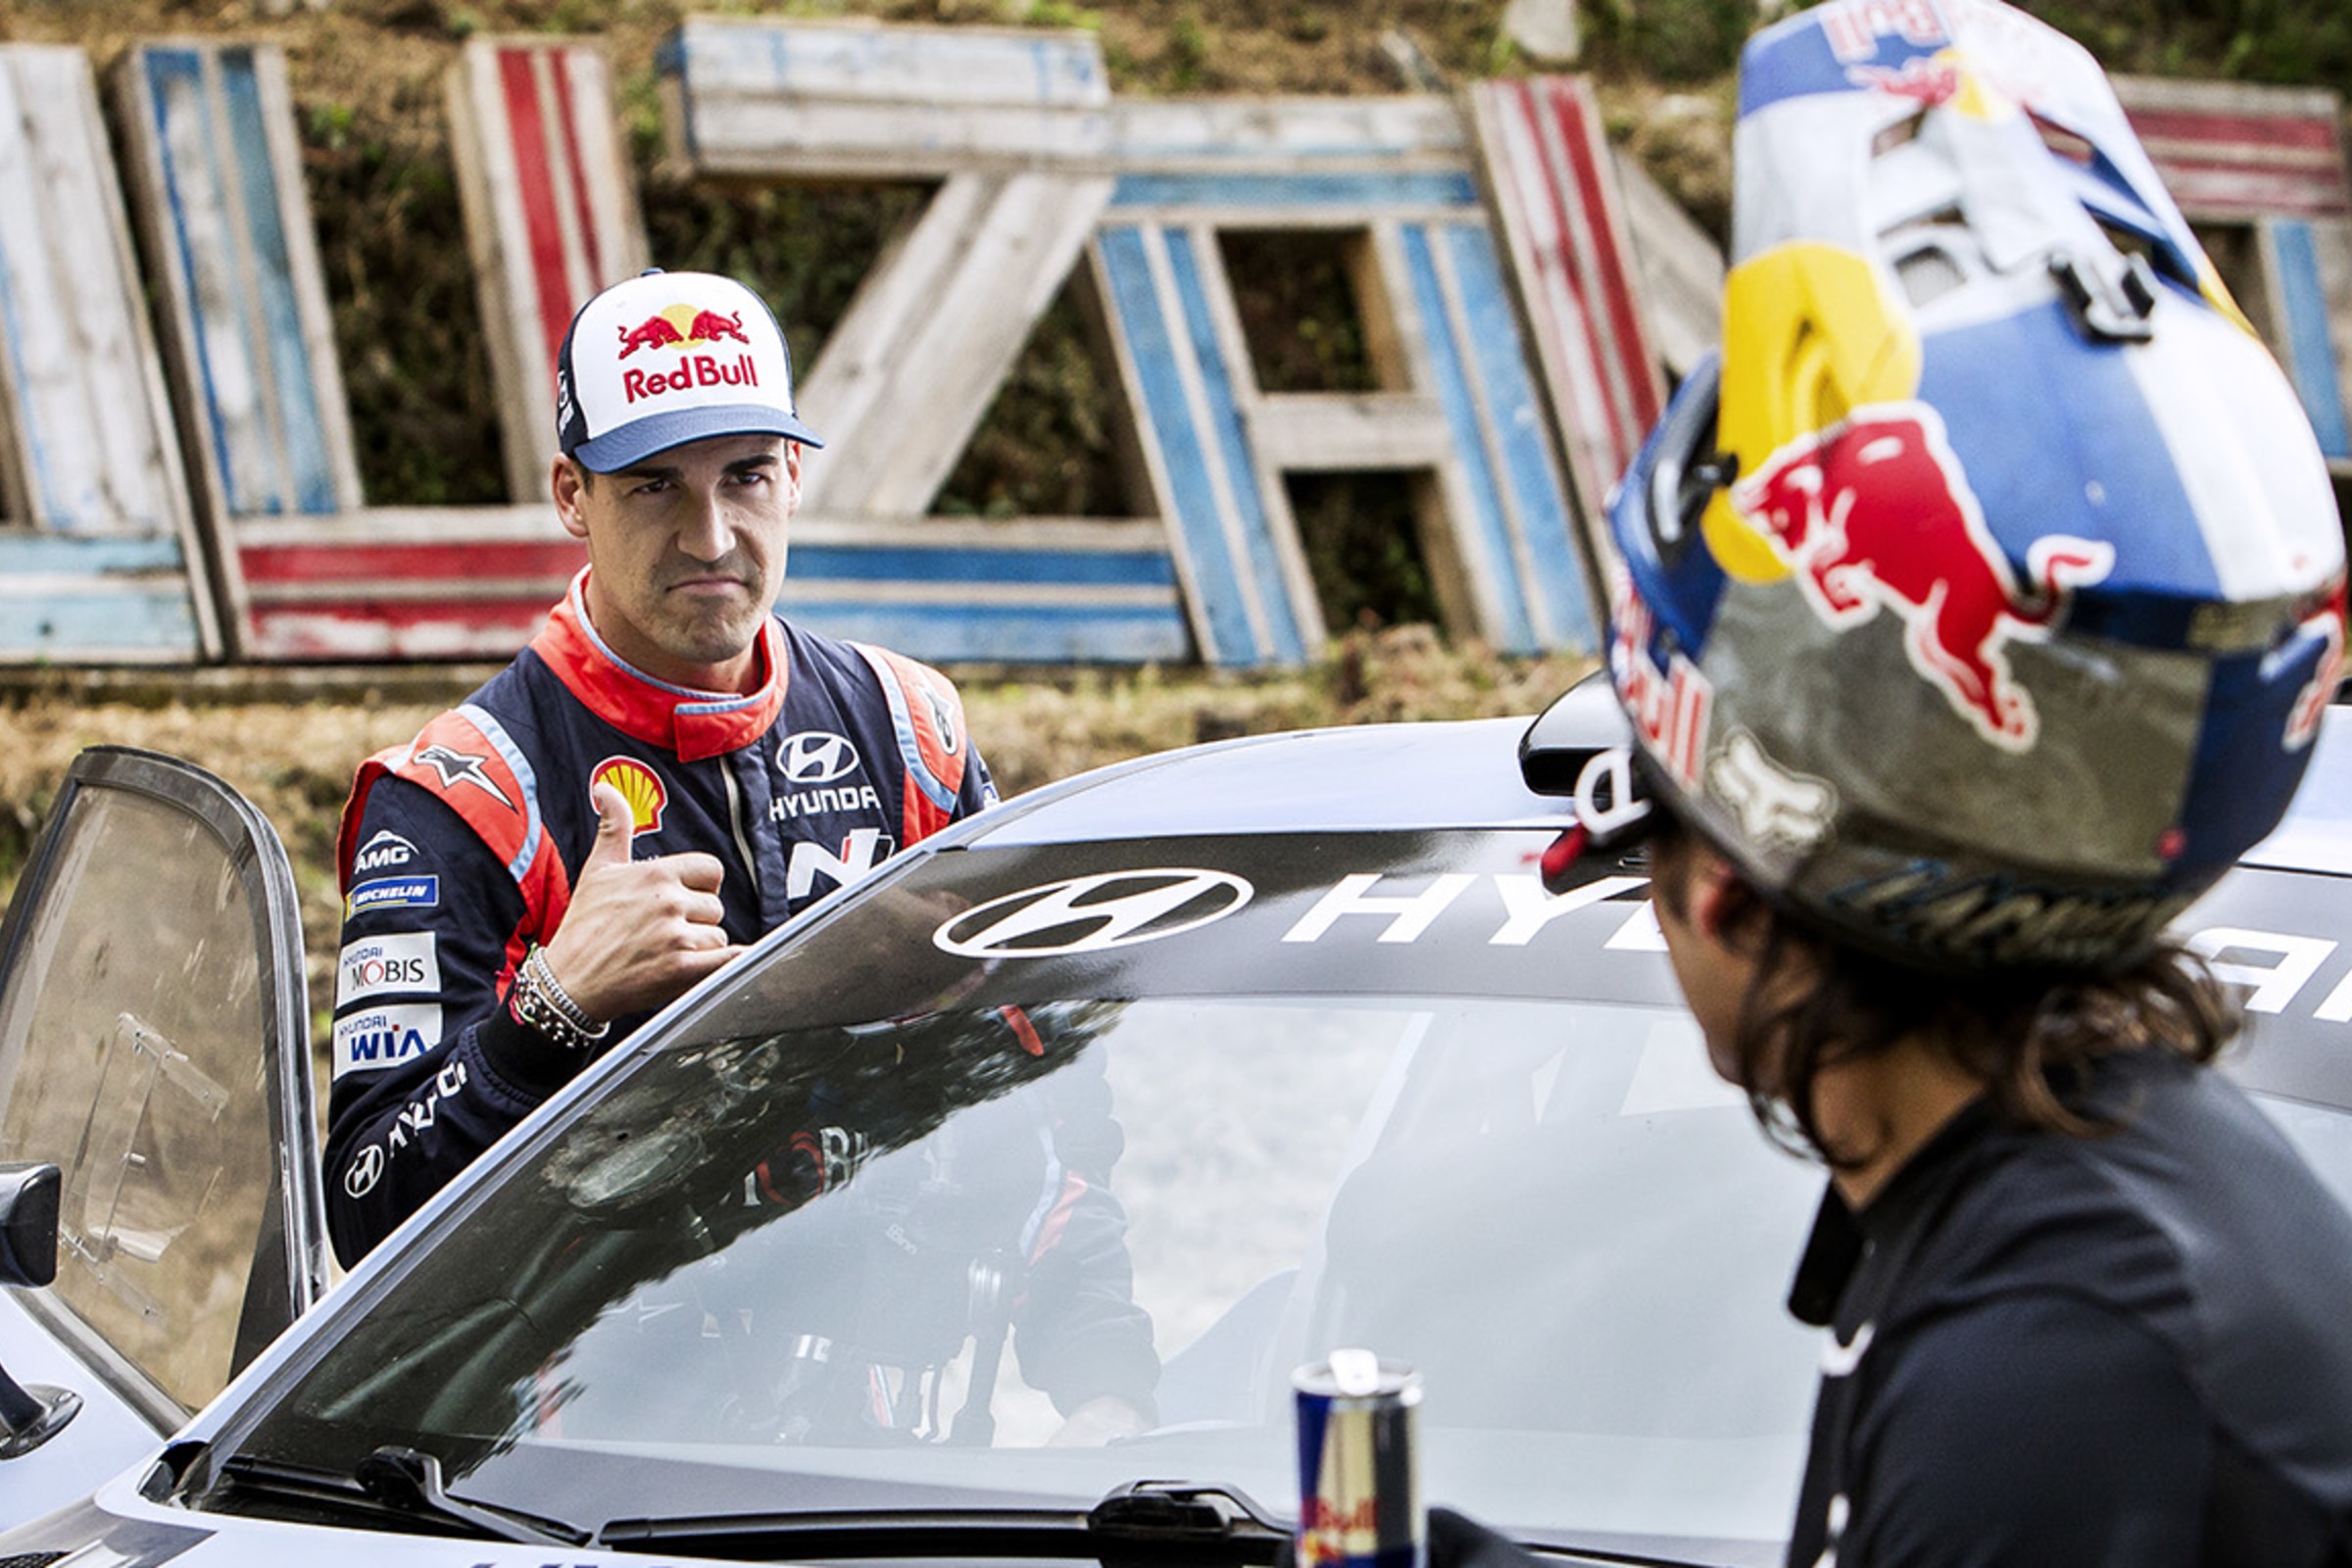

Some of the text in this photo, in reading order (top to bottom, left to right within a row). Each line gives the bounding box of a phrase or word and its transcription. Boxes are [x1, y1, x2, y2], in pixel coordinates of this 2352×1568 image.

[622, 354, 759, 403] Red Bull
[769, 786, 881, 821] HYUNDA
[356, 885, 428, 904] MICHELIN
[352, 958, 425, 991] MOBIS
[351, 1024, 427, 1062] WIA
